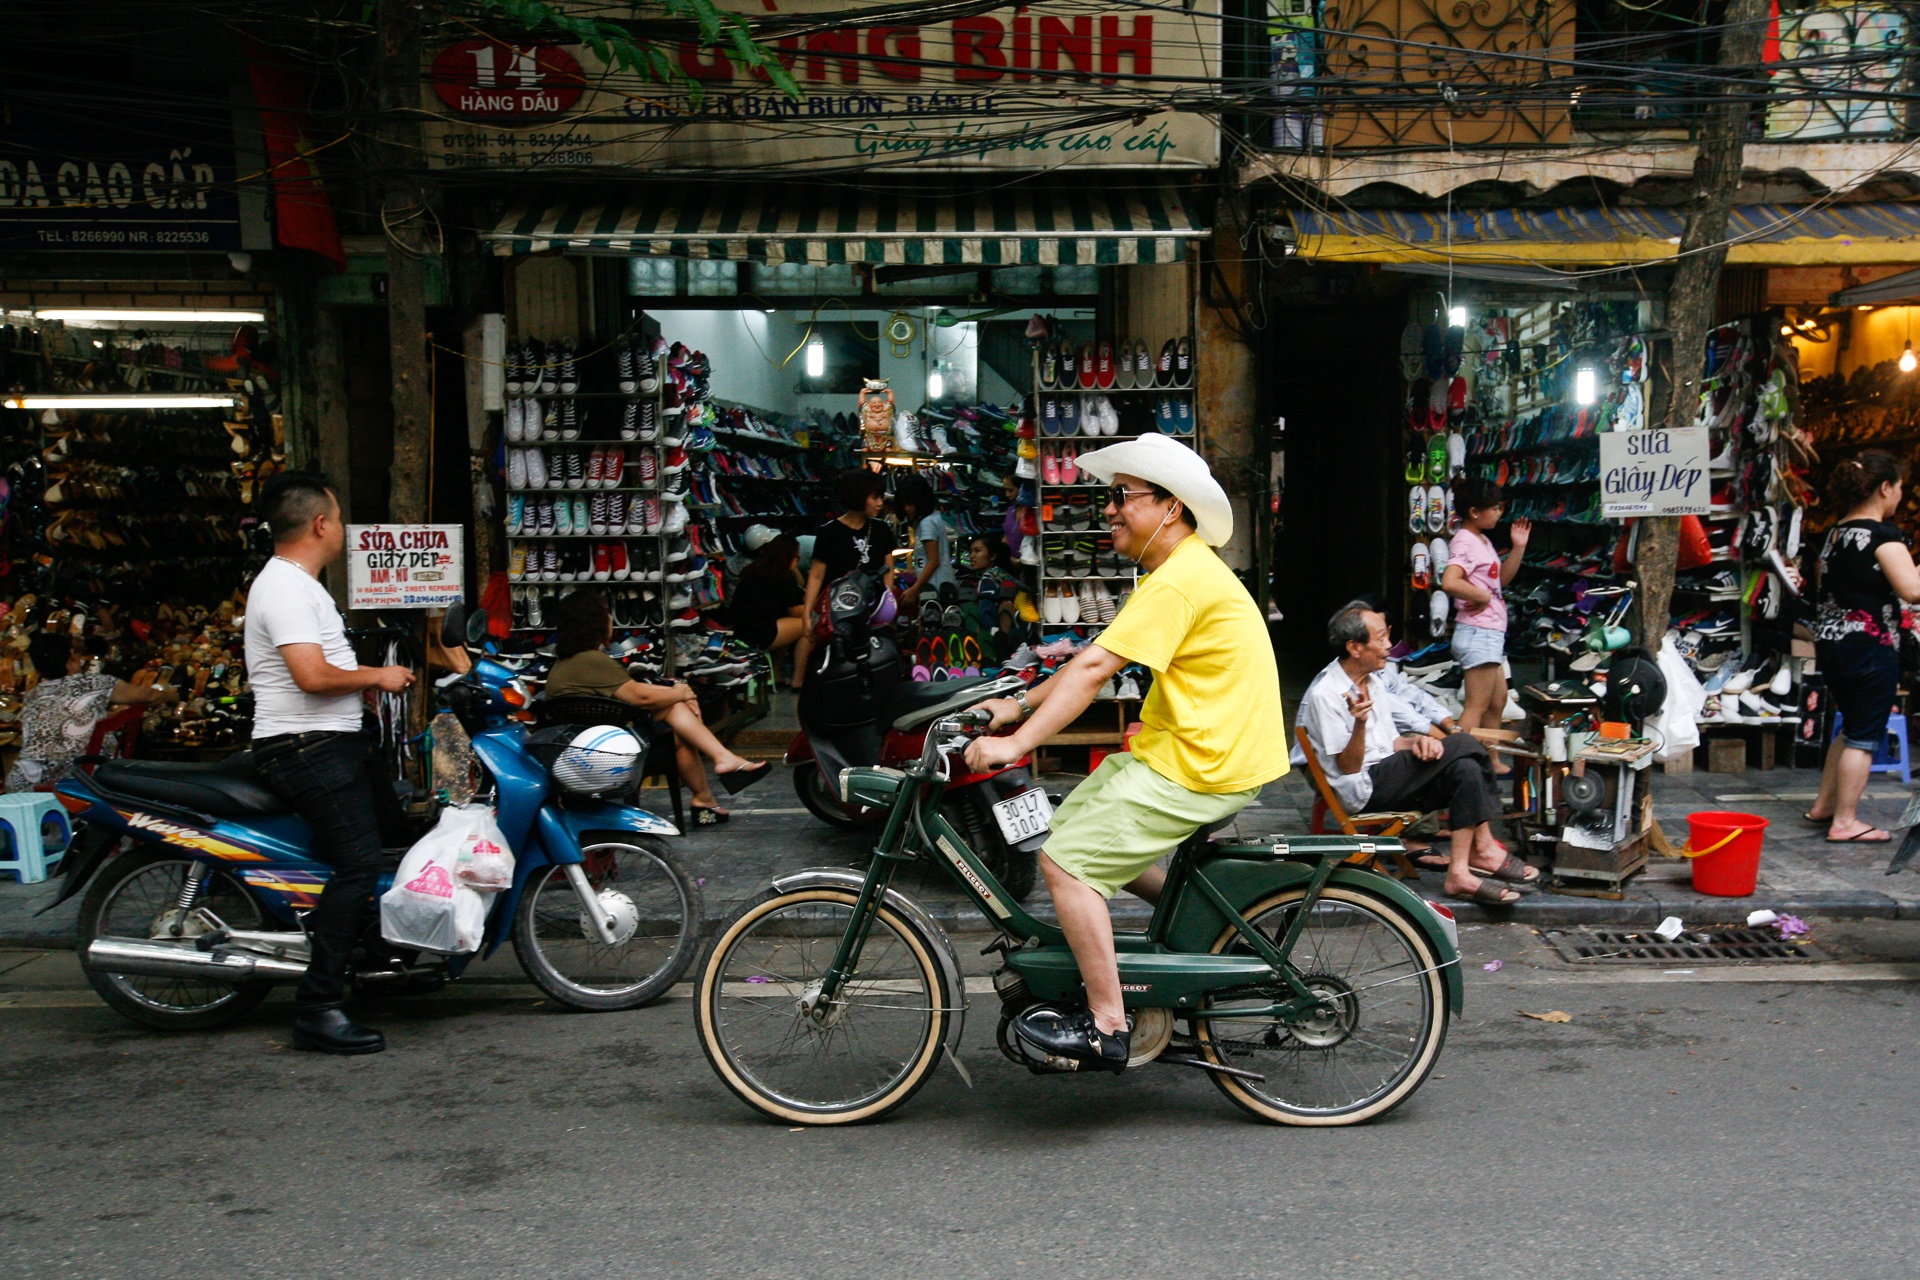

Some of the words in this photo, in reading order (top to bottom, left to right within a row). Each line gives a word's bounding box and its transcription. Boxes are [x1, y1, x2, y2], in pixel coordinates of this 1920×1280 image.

[466, 44, 547, 91] 14
[460, 91, 515, 112] HÀNG
[521, 91, 560, 112] DẦU
[1123, 121, 1177, 163] cấp
[57, 161, 134, 209] CAO
[143, 147, 214, 209] CẤP
[72, 231, 125, 243] 8266990
[156, 232, 209, 243] 8225536
[1329, 278, 1348, 294] 12
[370, 569, 390, 583] NAM
[127, 812, 209, 839] Wave
